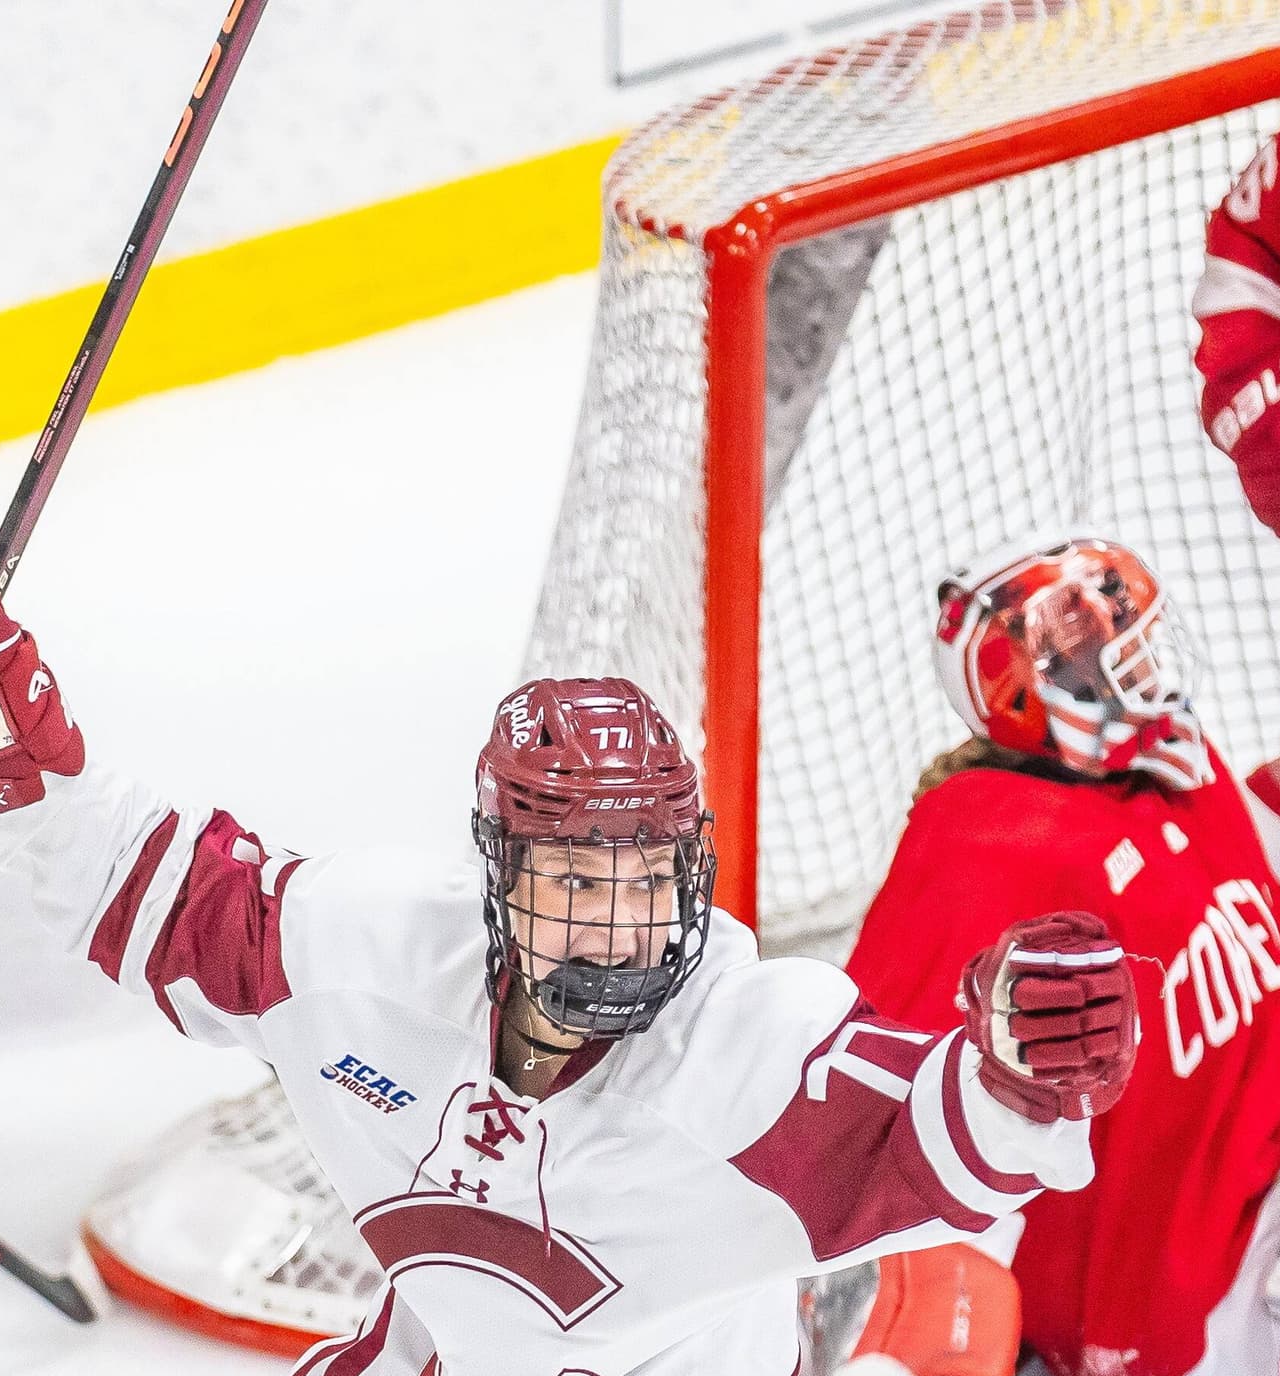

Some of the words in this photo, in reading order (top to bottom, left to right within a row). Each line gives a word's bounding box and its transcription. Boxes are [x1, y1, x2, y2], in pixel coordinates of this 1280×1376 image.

[589, 727, 630, 750] 77
[583, 797, 656, 810] BAUER
[586, 1002, 646, 1015] BAUER
[335, 1054, 418, 1108] ECAC
[336, 1074, 400, 1114] HOCKEY
